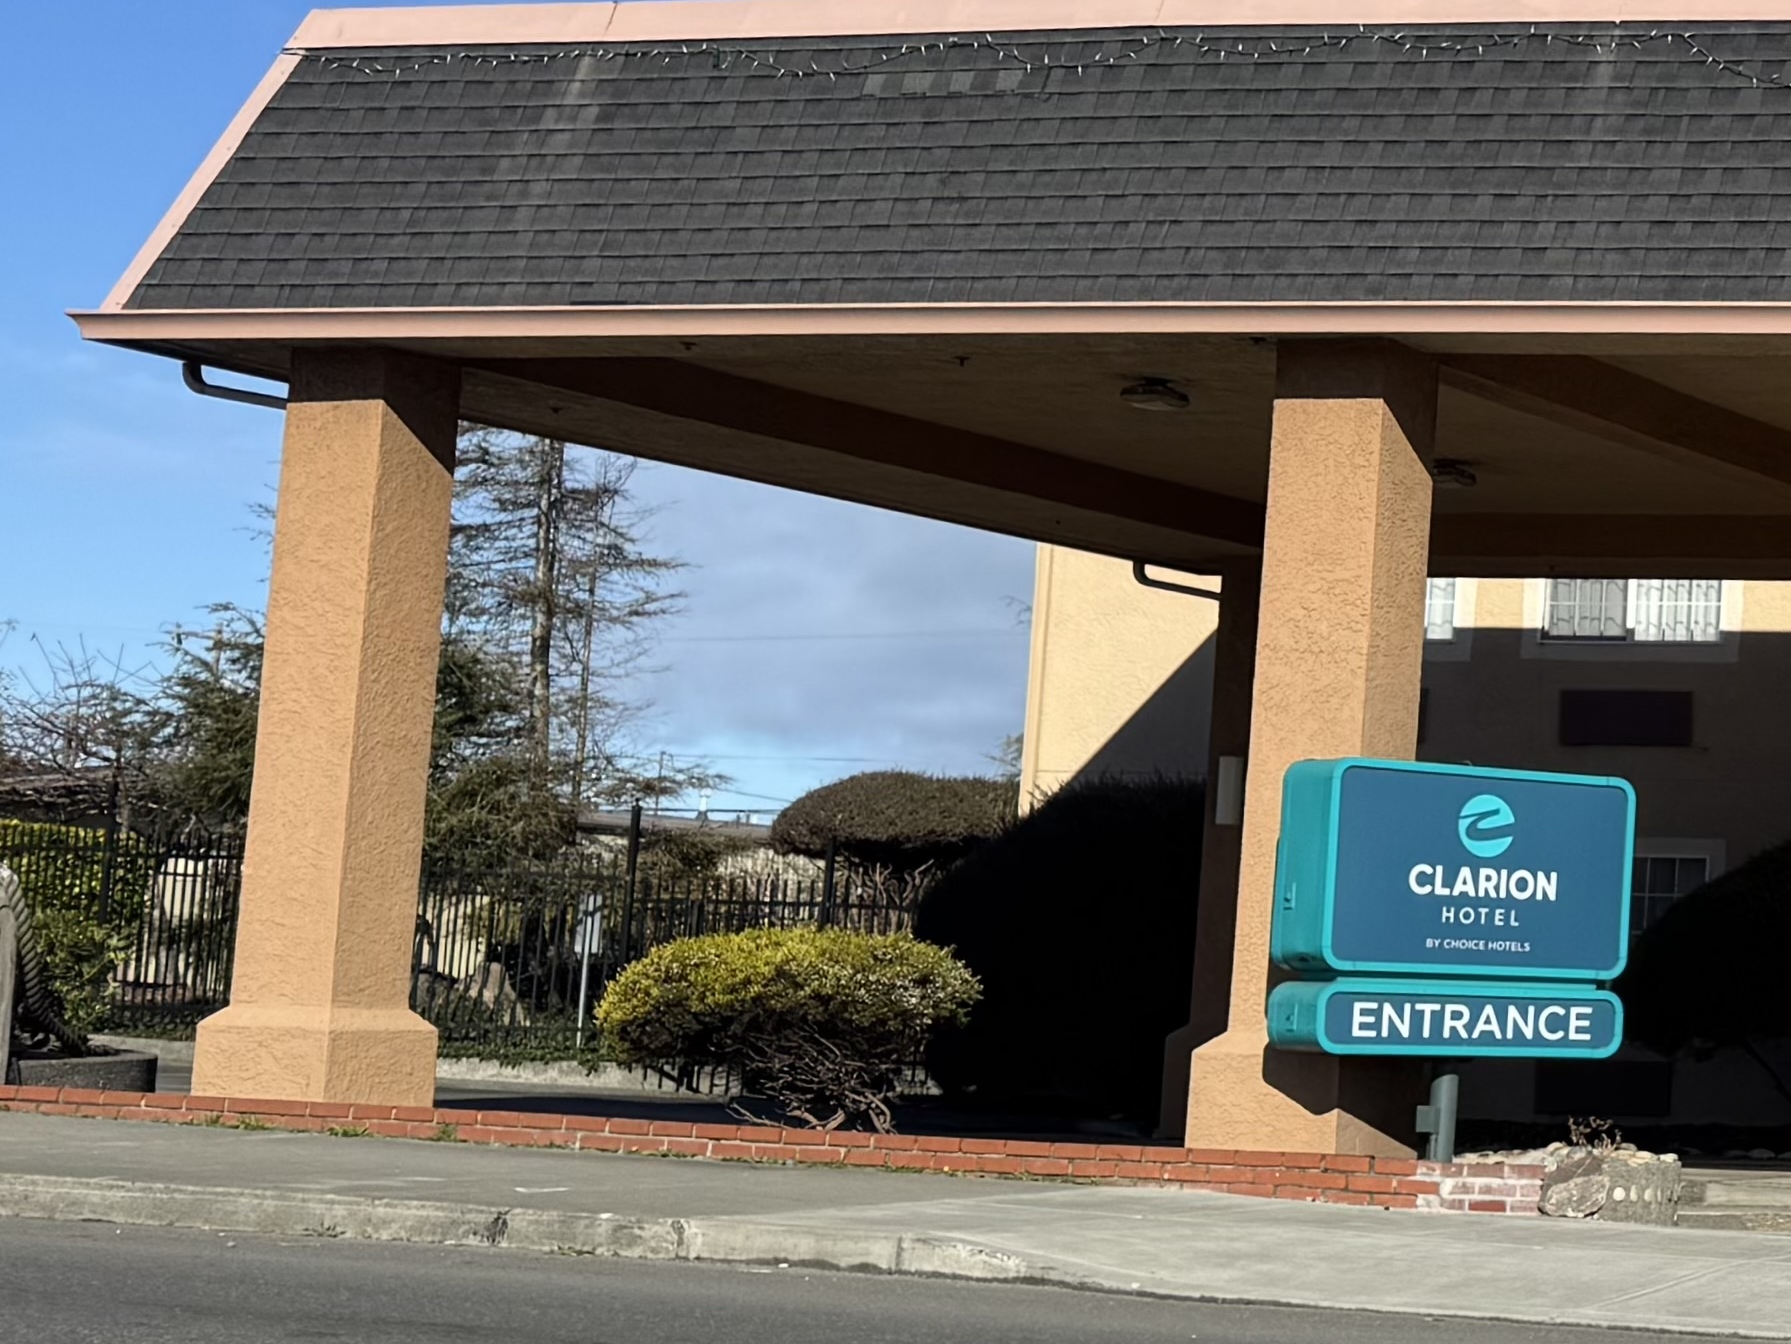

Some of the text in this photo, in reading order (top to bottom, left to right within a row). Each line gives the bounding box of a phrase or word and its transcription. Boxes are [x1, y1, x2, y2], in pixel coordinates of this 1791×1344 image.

[1408, 863, 1558, 901] CLARION
[1441, 906, 1520, 927] HOTEL
[1425, 938, 1531, 953] BY CHOICE HOTELS
[1351, 1001, 1593, 1041] ENTRANCE
